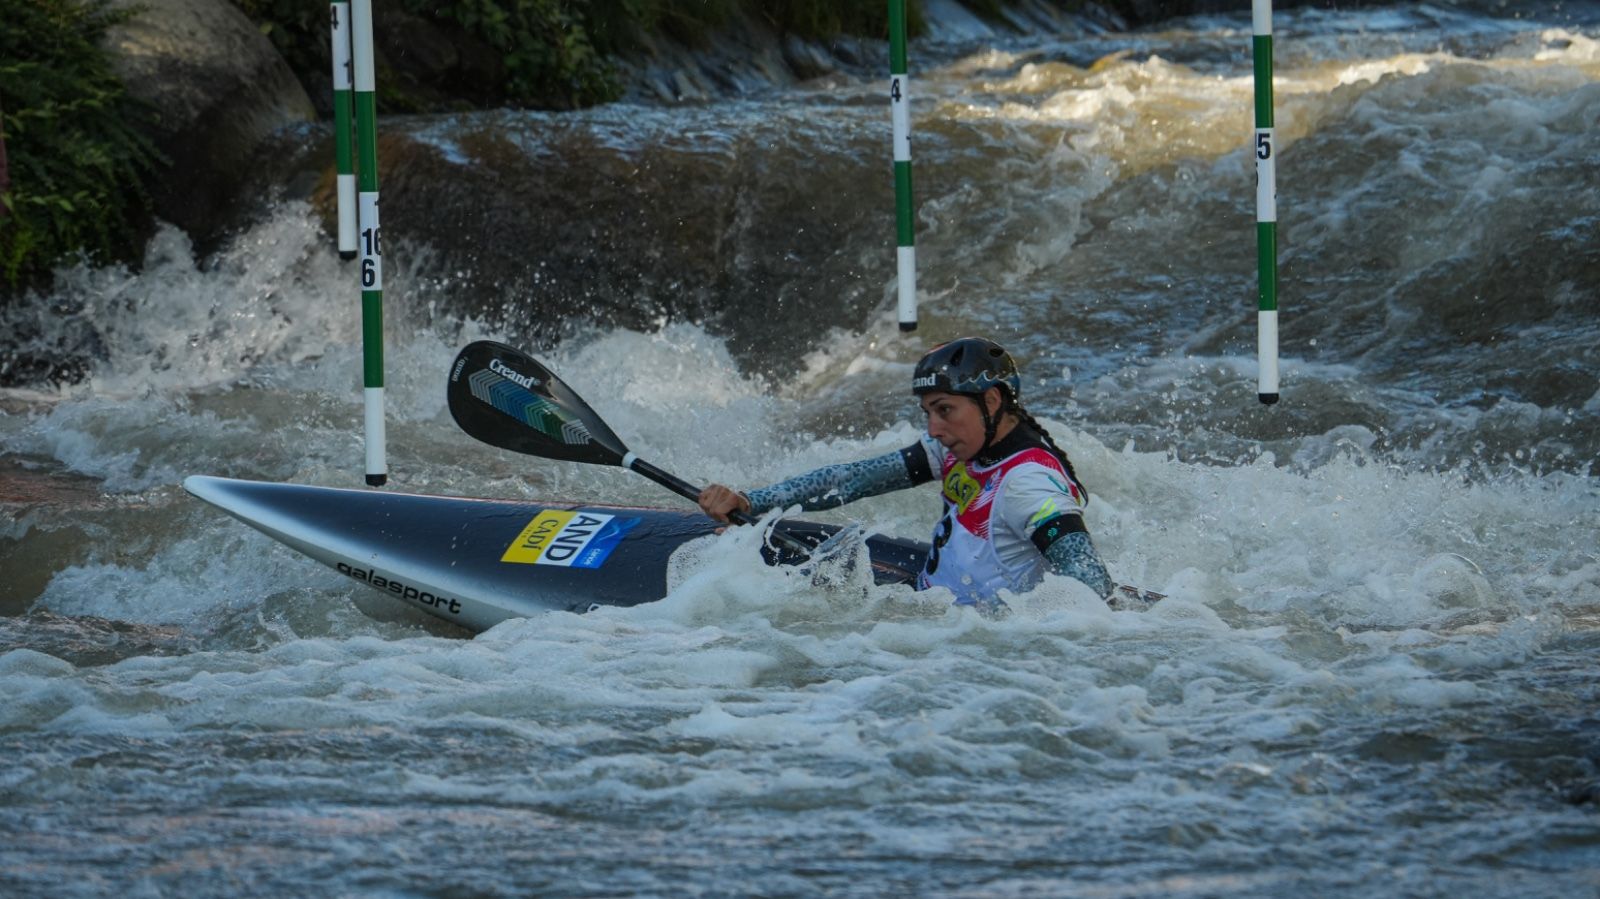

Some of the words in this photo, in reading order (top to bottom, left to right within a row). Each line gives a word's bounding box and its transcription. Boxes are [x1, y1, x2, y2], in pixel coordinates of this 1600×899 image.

[891, 78, 902, 103] 4
[1257, 132, 1271, 160] 5
[362, 258, 375, 287] 6
[489, 358, 535, 389] Creand
[545, 514, 603, 561] AND
